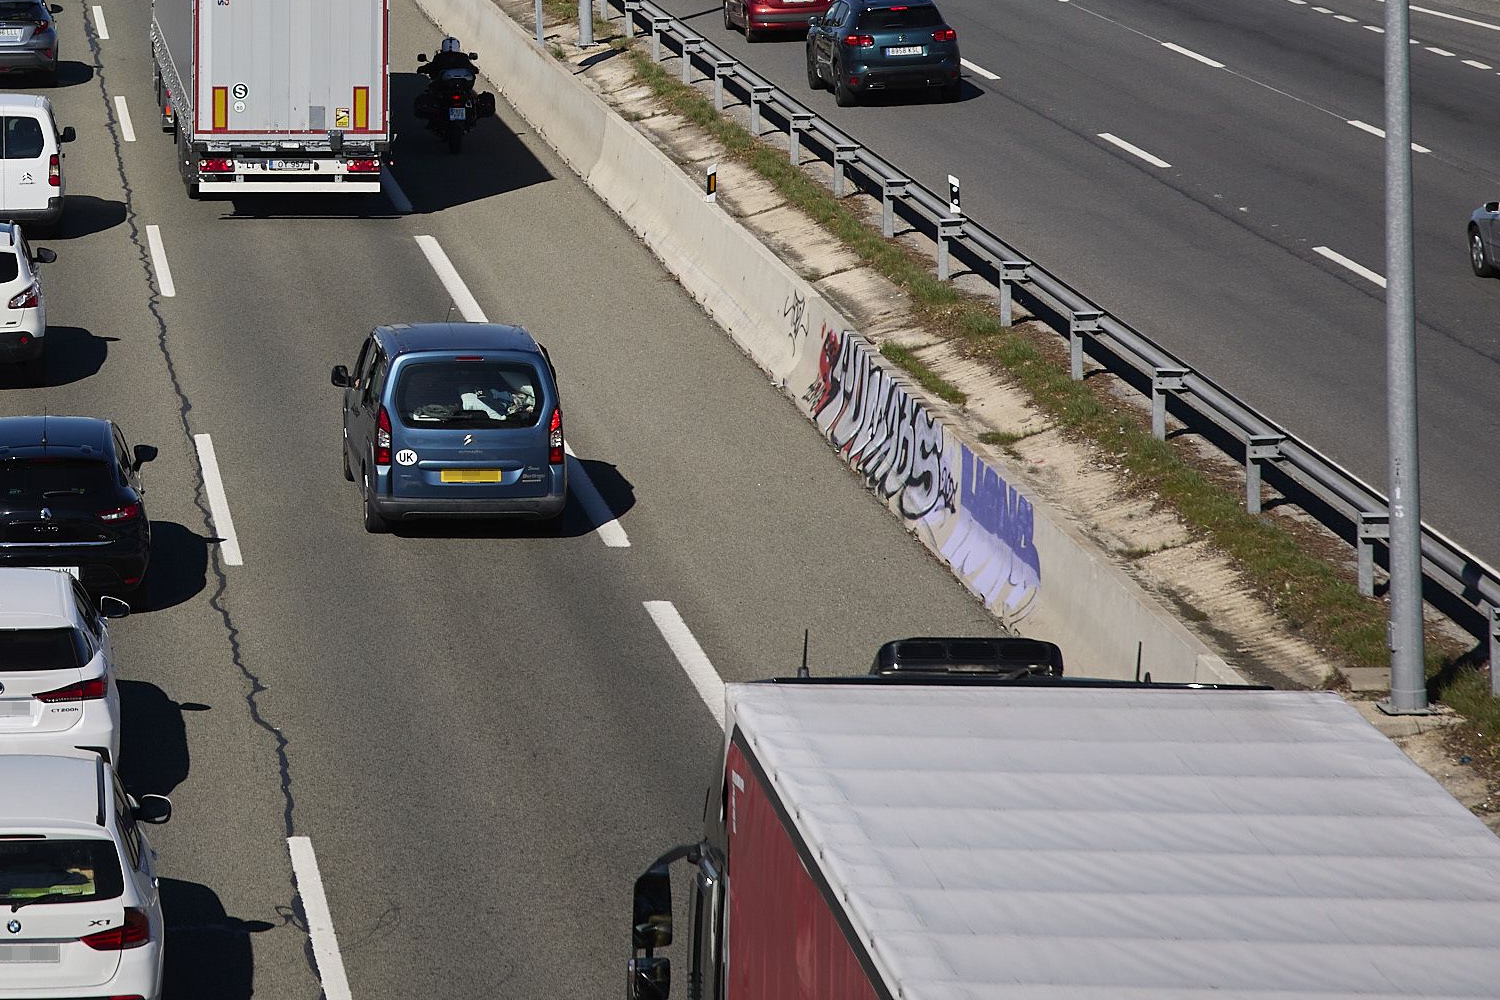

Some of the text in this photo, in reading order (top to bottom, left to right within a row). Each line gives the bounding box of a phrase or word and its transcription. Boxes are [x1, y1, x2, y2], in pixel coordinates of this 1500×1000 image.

[235, 85, 246, 98] S
[399, 452, 414, 463] UK
[88, 918, 112, 927] X1
